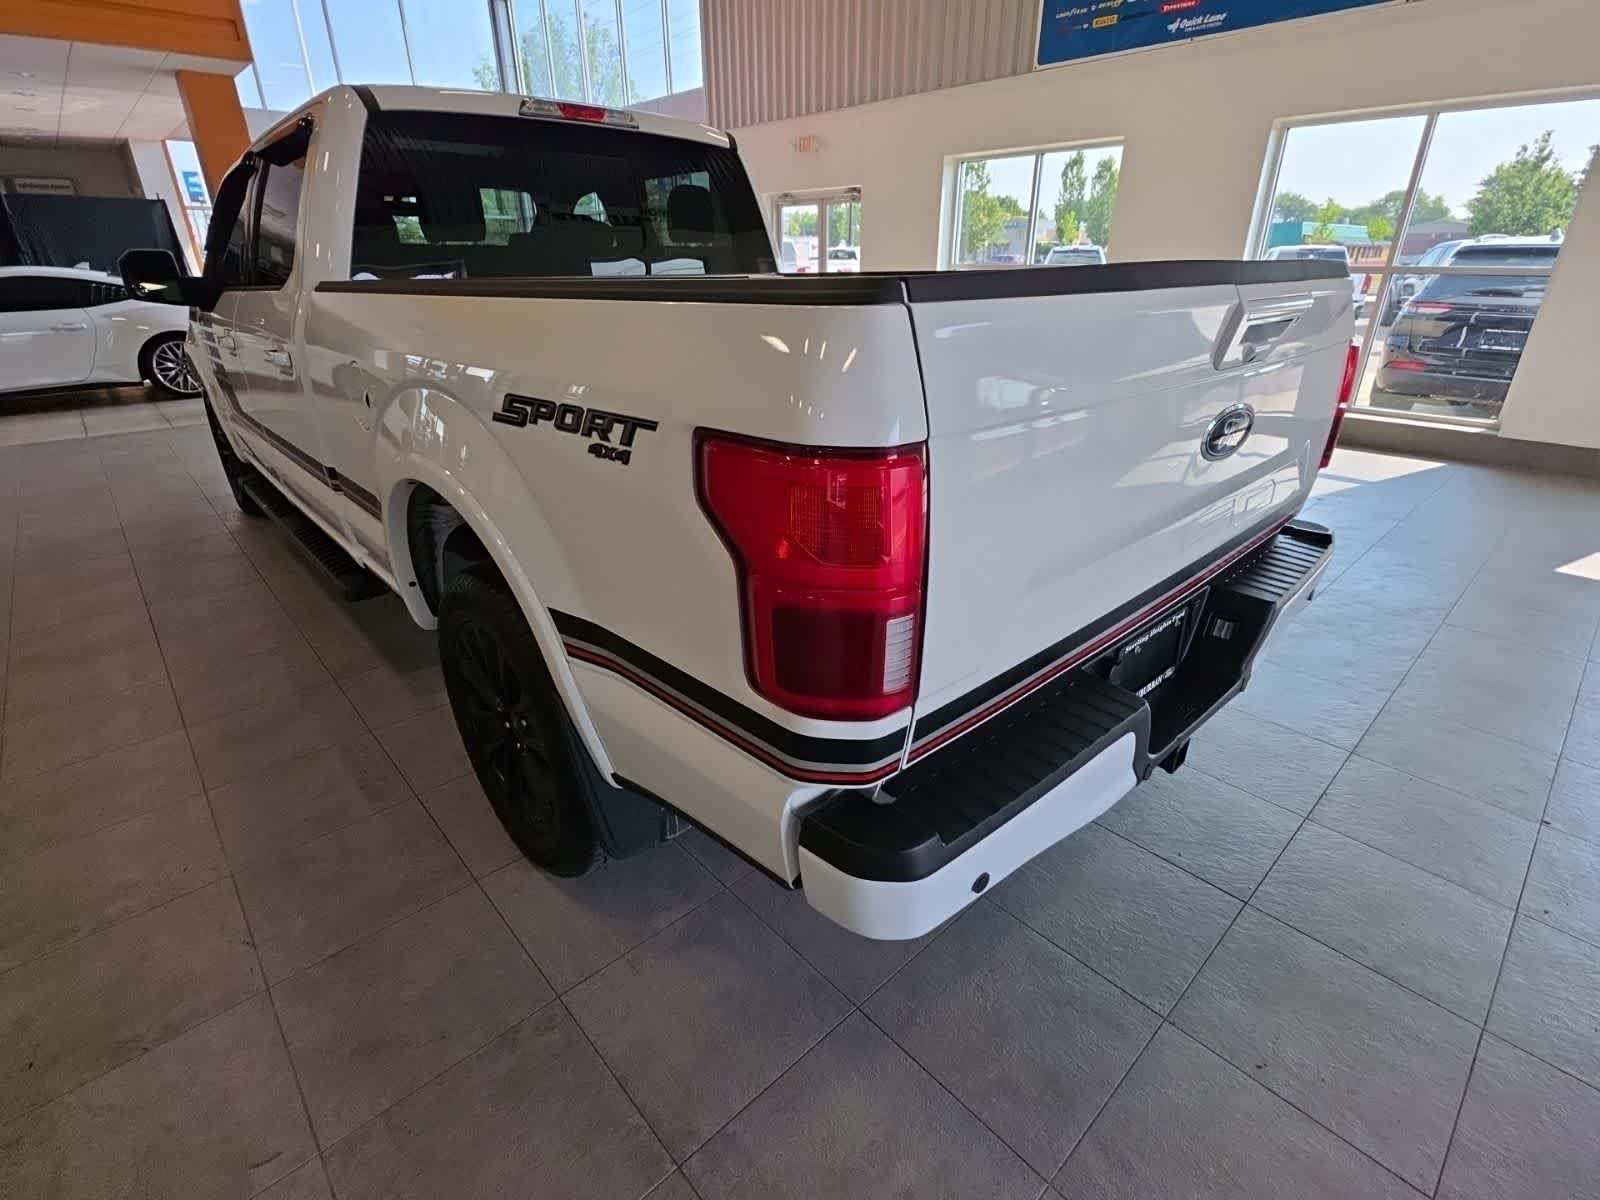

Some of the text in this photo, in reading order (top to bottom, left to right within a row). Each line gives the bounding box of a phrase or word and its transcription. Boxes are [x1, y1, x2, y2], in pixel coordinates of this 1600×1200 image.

[1179, 16, 1203, 29] Quick
[1203, 13, 1227, 23] Lane
[492, 393, 659, 447] SPORT
